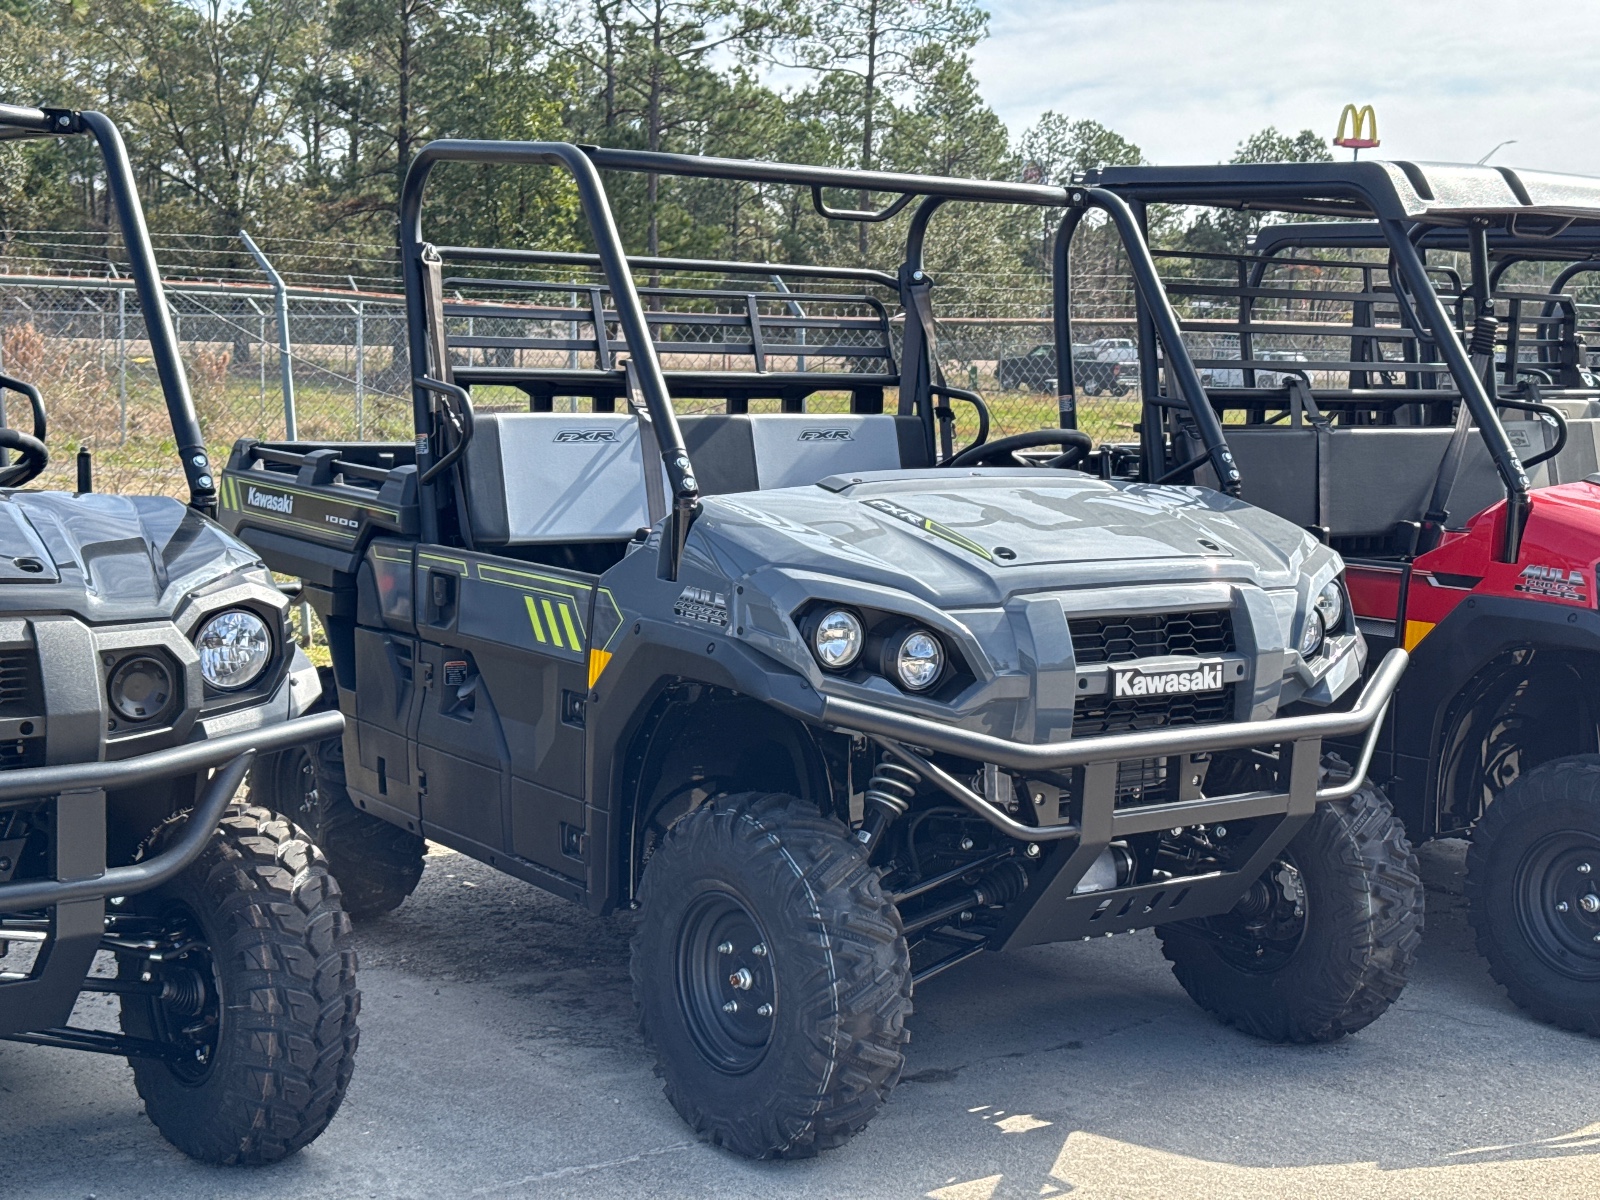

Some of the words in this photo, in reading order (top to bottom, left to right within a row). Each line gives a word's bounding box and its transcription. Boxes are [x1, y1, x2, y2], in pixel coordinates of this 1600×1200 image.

[554, 430, 619, 442] FXR
[799, 429, 854, 441] FXR
[248, 487, 293, 514] Kawasaki
[326, 514, 358, 528] 1000
[1115, 664, 1223, 697] Kawasaki
